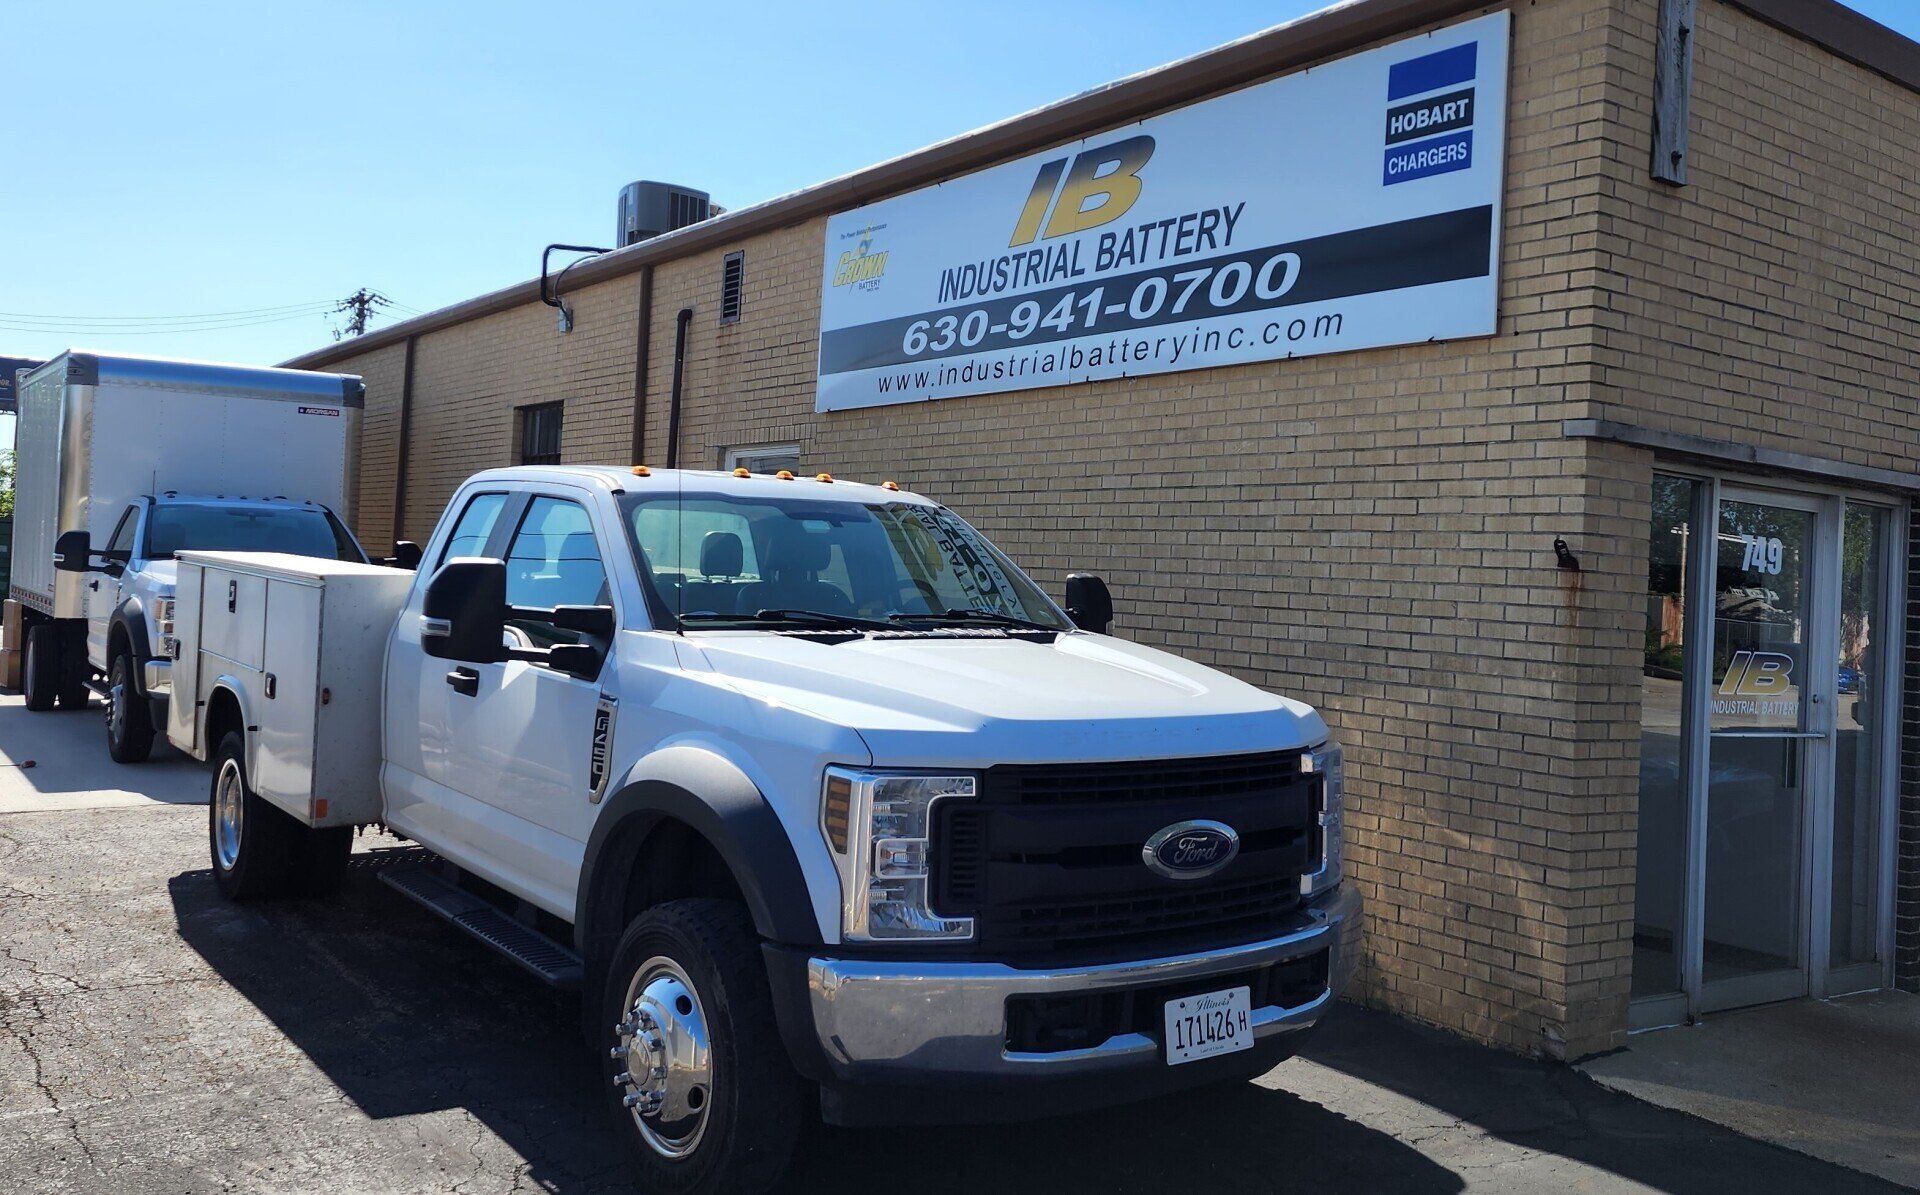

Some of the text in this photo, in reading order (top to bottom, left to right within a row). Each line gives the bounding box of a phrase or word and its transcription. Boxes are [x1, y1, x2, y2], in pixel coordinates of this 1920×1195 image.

[1390, 99, 1469, 135] HOBART
[1388, 142, 1467, 175] CHARGERS
[1008, 135, 1156, 248] IB
[938, 201, 1246, 303] INDUSTRIAL BATTERY
[902, 252, 1301, 356] 630-941-0700
[877, 312, 1344, 394] www.industrialbatteryinc.com
[1741, 534, 1783, 575] 749
[1718, 650, 1794, 695] IB
[1711, 700, 1799, 715] INDUSTRIAL BATTERY
[1174, 837, 1218, 863] Ford
[1195, 995, 1230, 1012] Illinois
[1176, 1009, 1247, 1050] 171426 H
